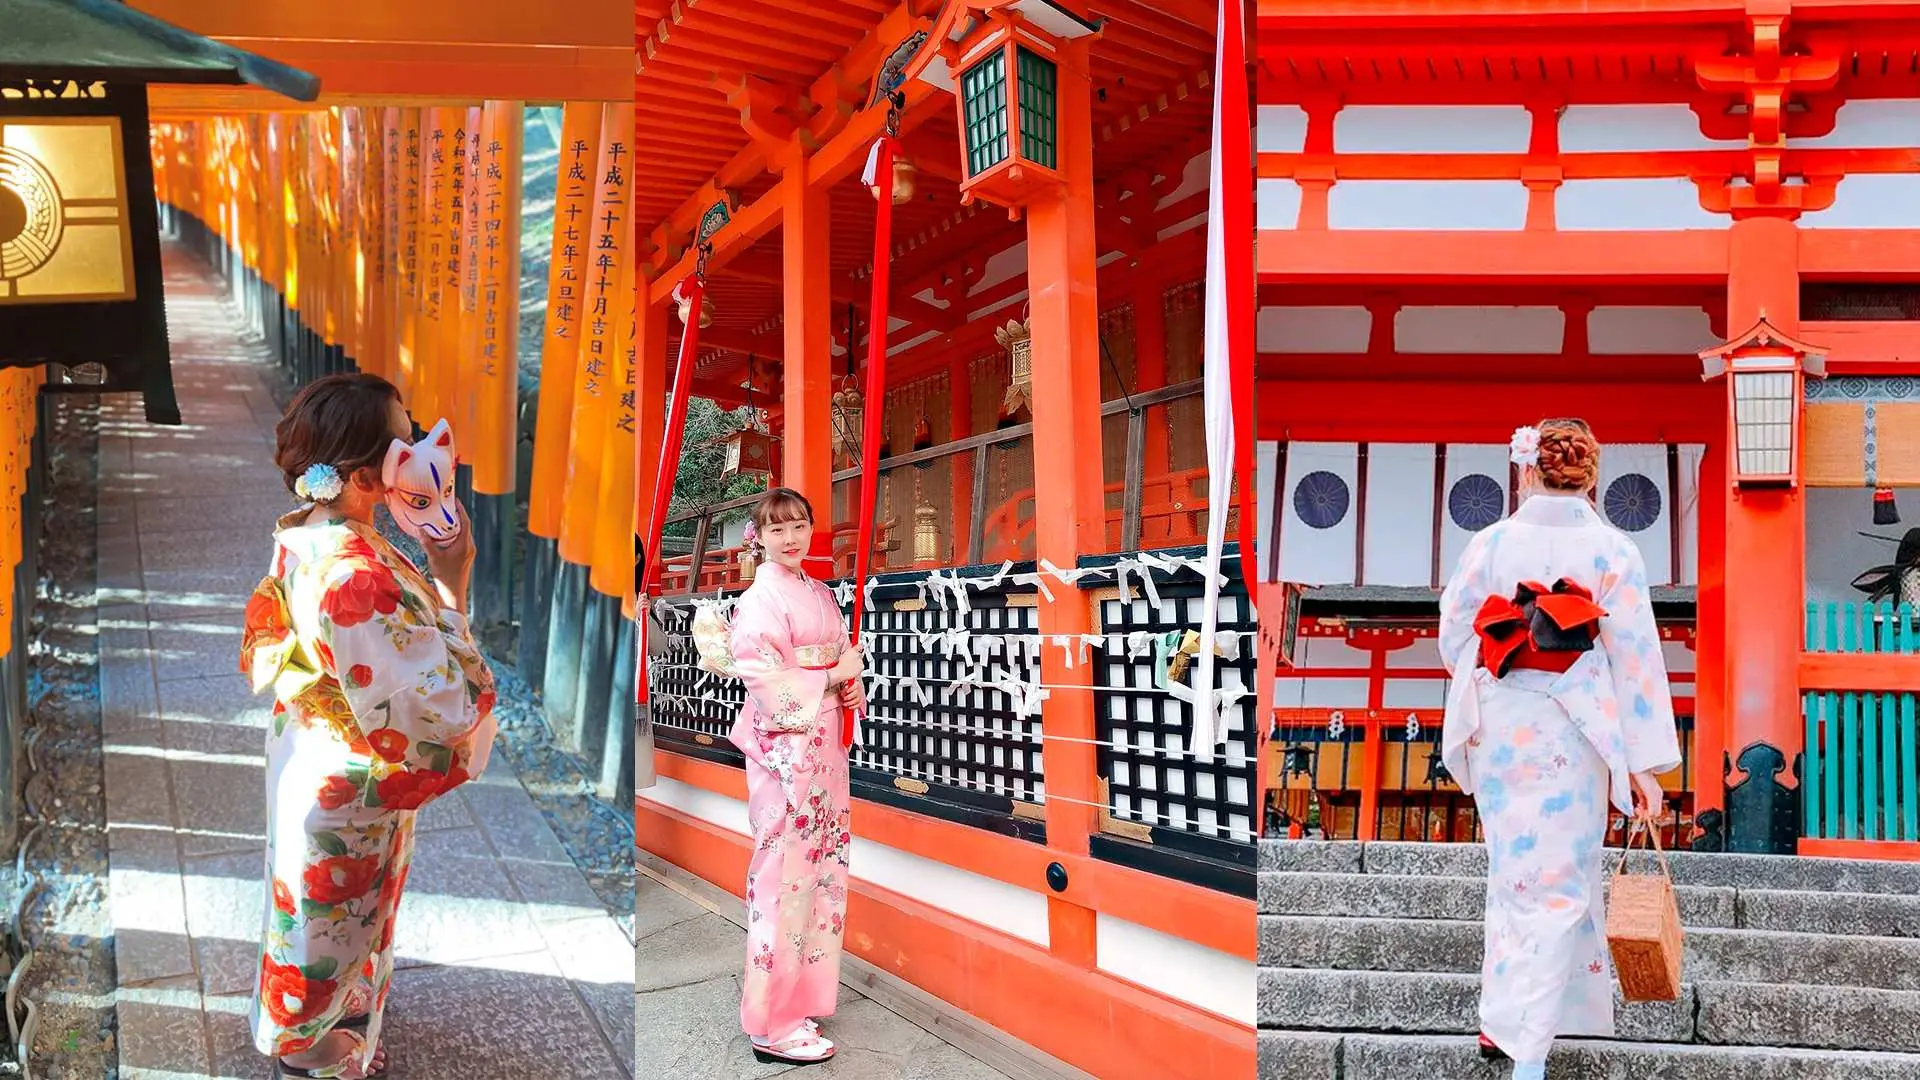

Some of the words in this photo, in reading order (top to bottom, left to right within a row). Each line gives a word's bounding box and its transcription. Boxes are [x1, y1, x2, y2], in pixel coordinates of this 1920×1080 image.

[446, 127, 466, 288] 令和元年五月吉日建之
[481, 140, 503, 378] 平成二十四年十二月吉日建之
[553, 139, 589, 339] 平成二十七年元旦建之
[584, 142, 628, 397] 平成二十五年十月吉日建之
